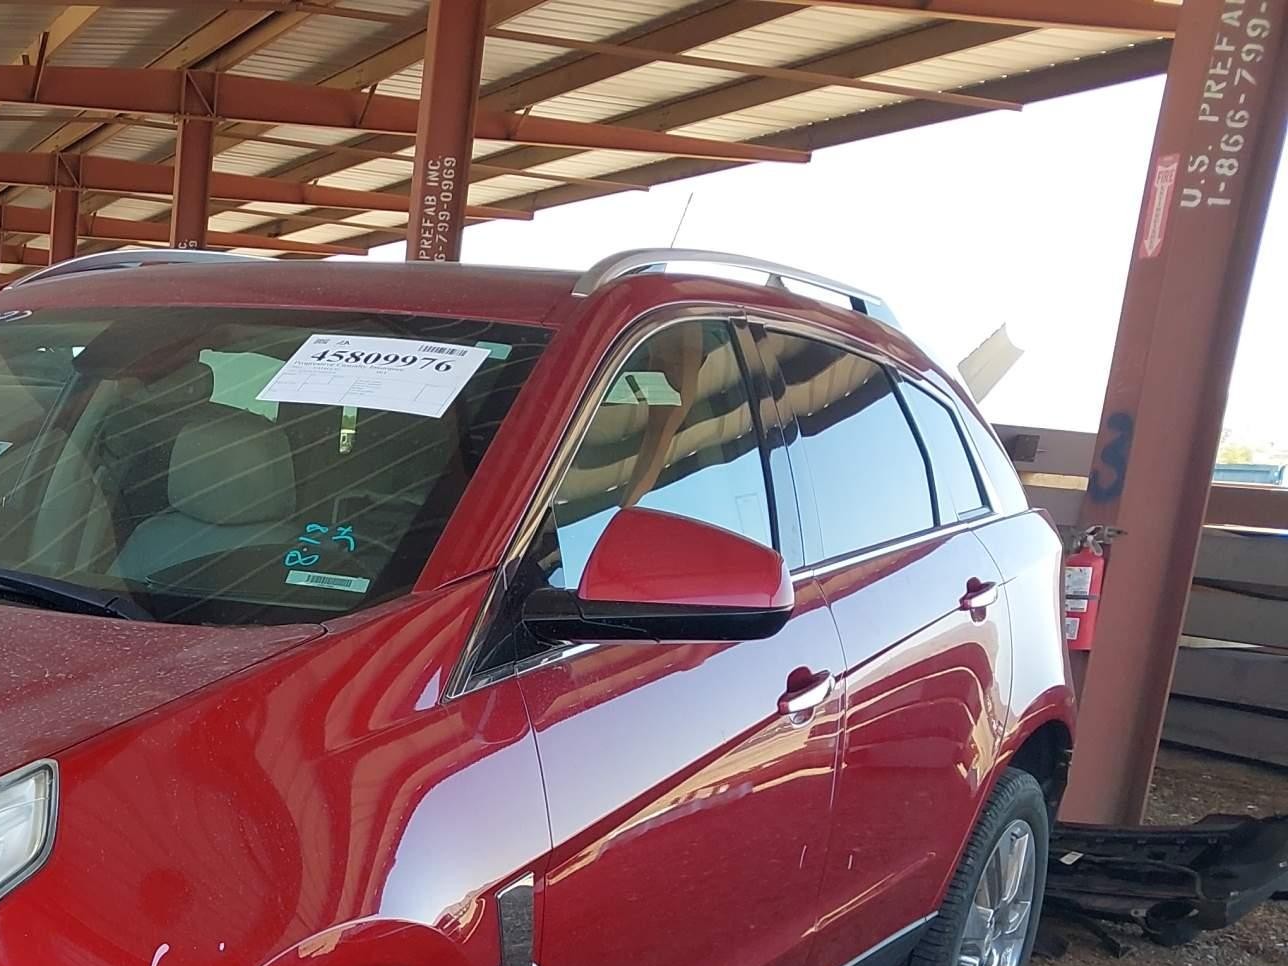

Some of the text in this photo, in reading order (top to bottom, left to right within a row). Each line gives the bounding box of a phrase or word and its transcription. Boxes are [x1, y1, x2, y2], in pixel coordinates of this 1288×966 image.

[1180, 0, 1246, 208] U.S. PREFA
[418, 195, 437, 260] PREFAB
[311, 348, 453, 373] 45809976
